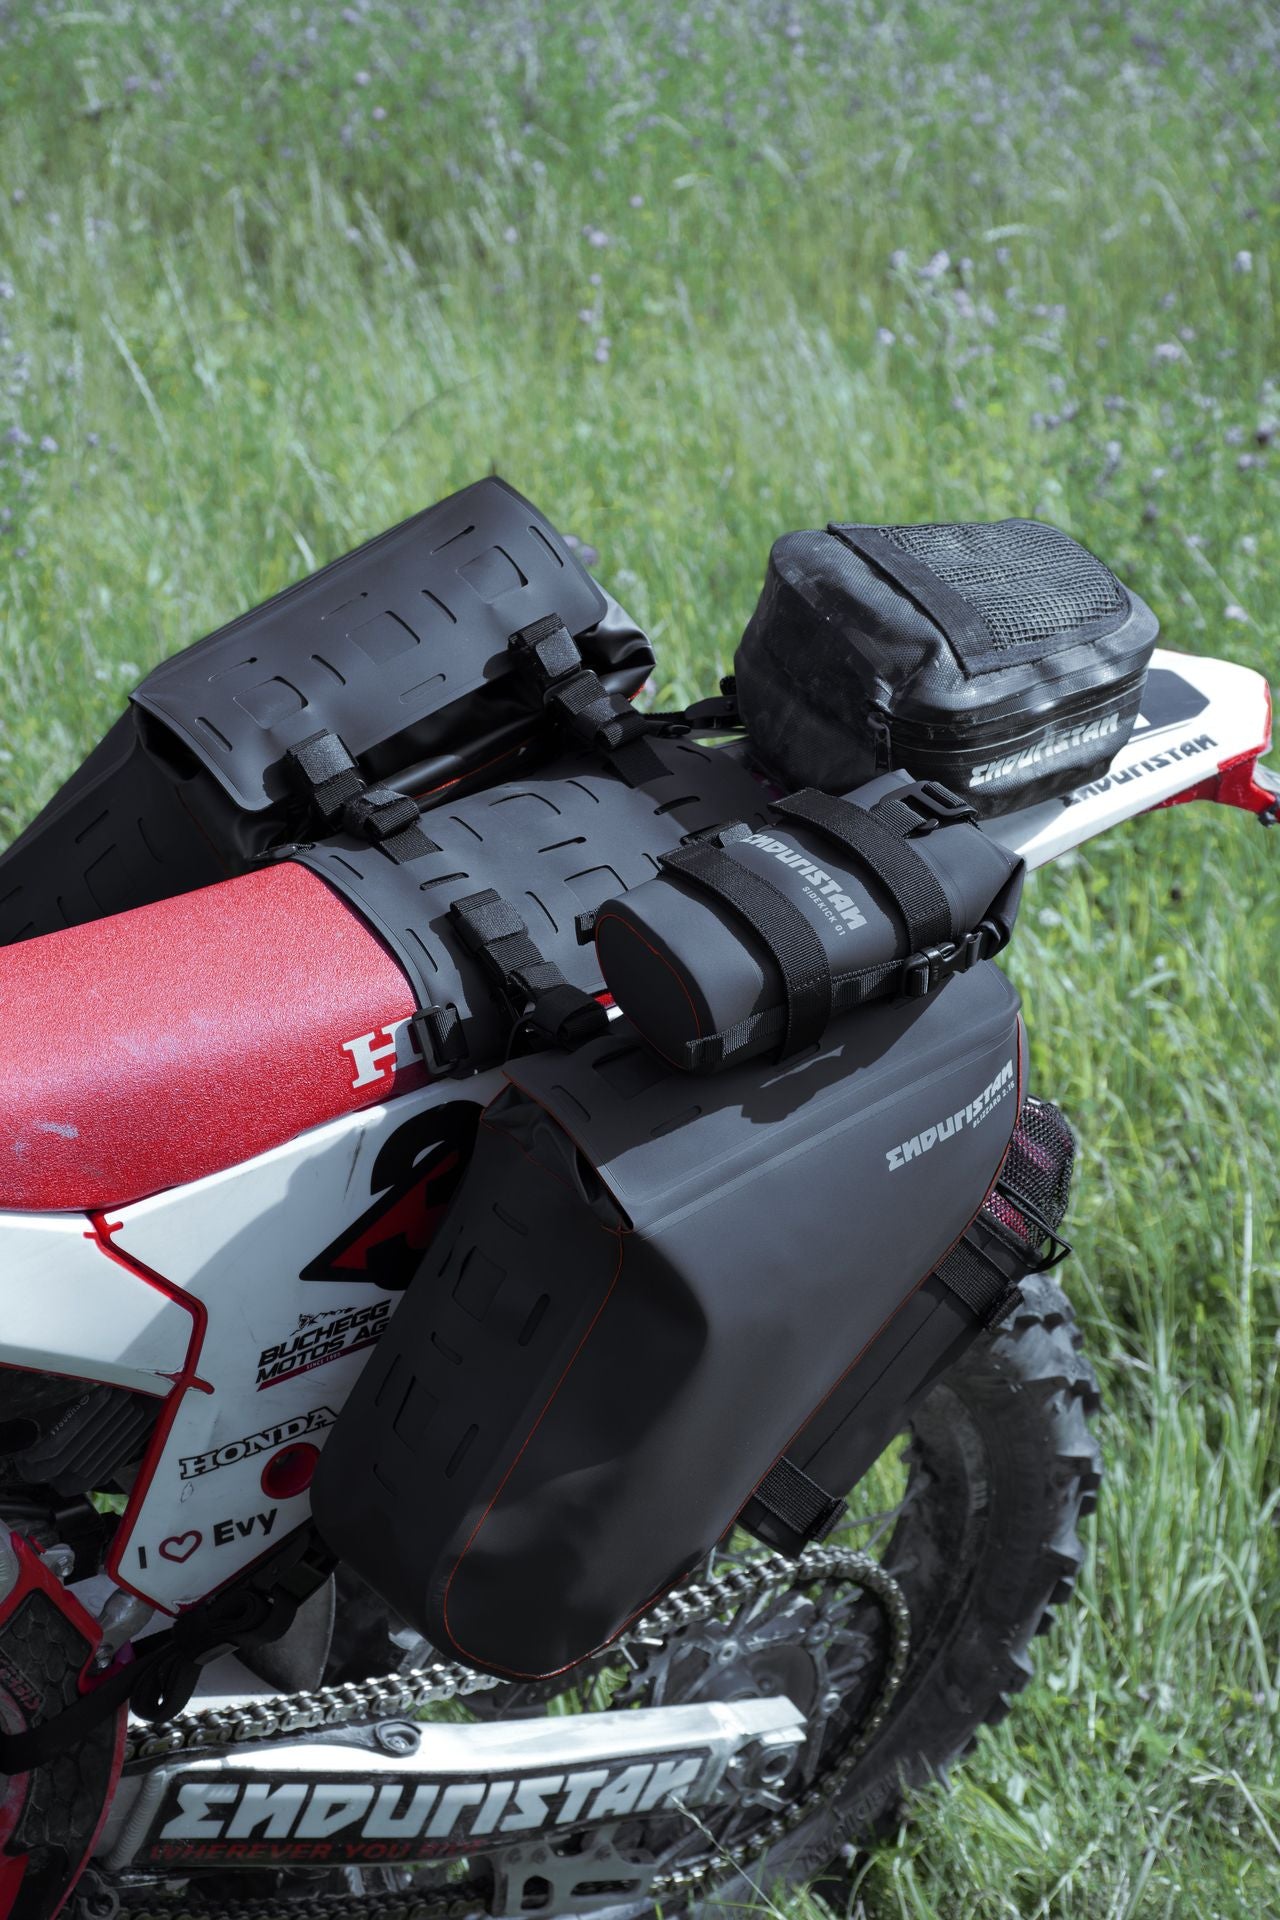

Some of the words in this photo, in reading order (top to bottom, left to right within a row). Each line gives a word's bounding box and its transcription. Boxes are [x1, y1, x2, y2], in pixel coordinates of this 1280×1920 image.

[969, 713, 1121, 788] ENDURISTAN
[802, 886, 838, 924] SIDEKICK
[834, 925, 847, 937] 01
[885, 1059, 1014, 1172] ENDURISTAN
[972, 1094, 1002, 1129] BLIZZARD
[255, 1334, 345, 1384] MOTOS
[352, 1317, 390, 1345] AG
[258, 1299, 392, 1369] BUCHEGG
[178, 1406, 340, 1481] HONDA
[138, 1546, 148, 1570] I
[213, 1508, 279, 1548] Evy
[158, 1756, 703, 1839] ENDURISTAN
[150, 1842, 334, 1861] WHEREVER
[344, 1843, 411, 1861] YOU
